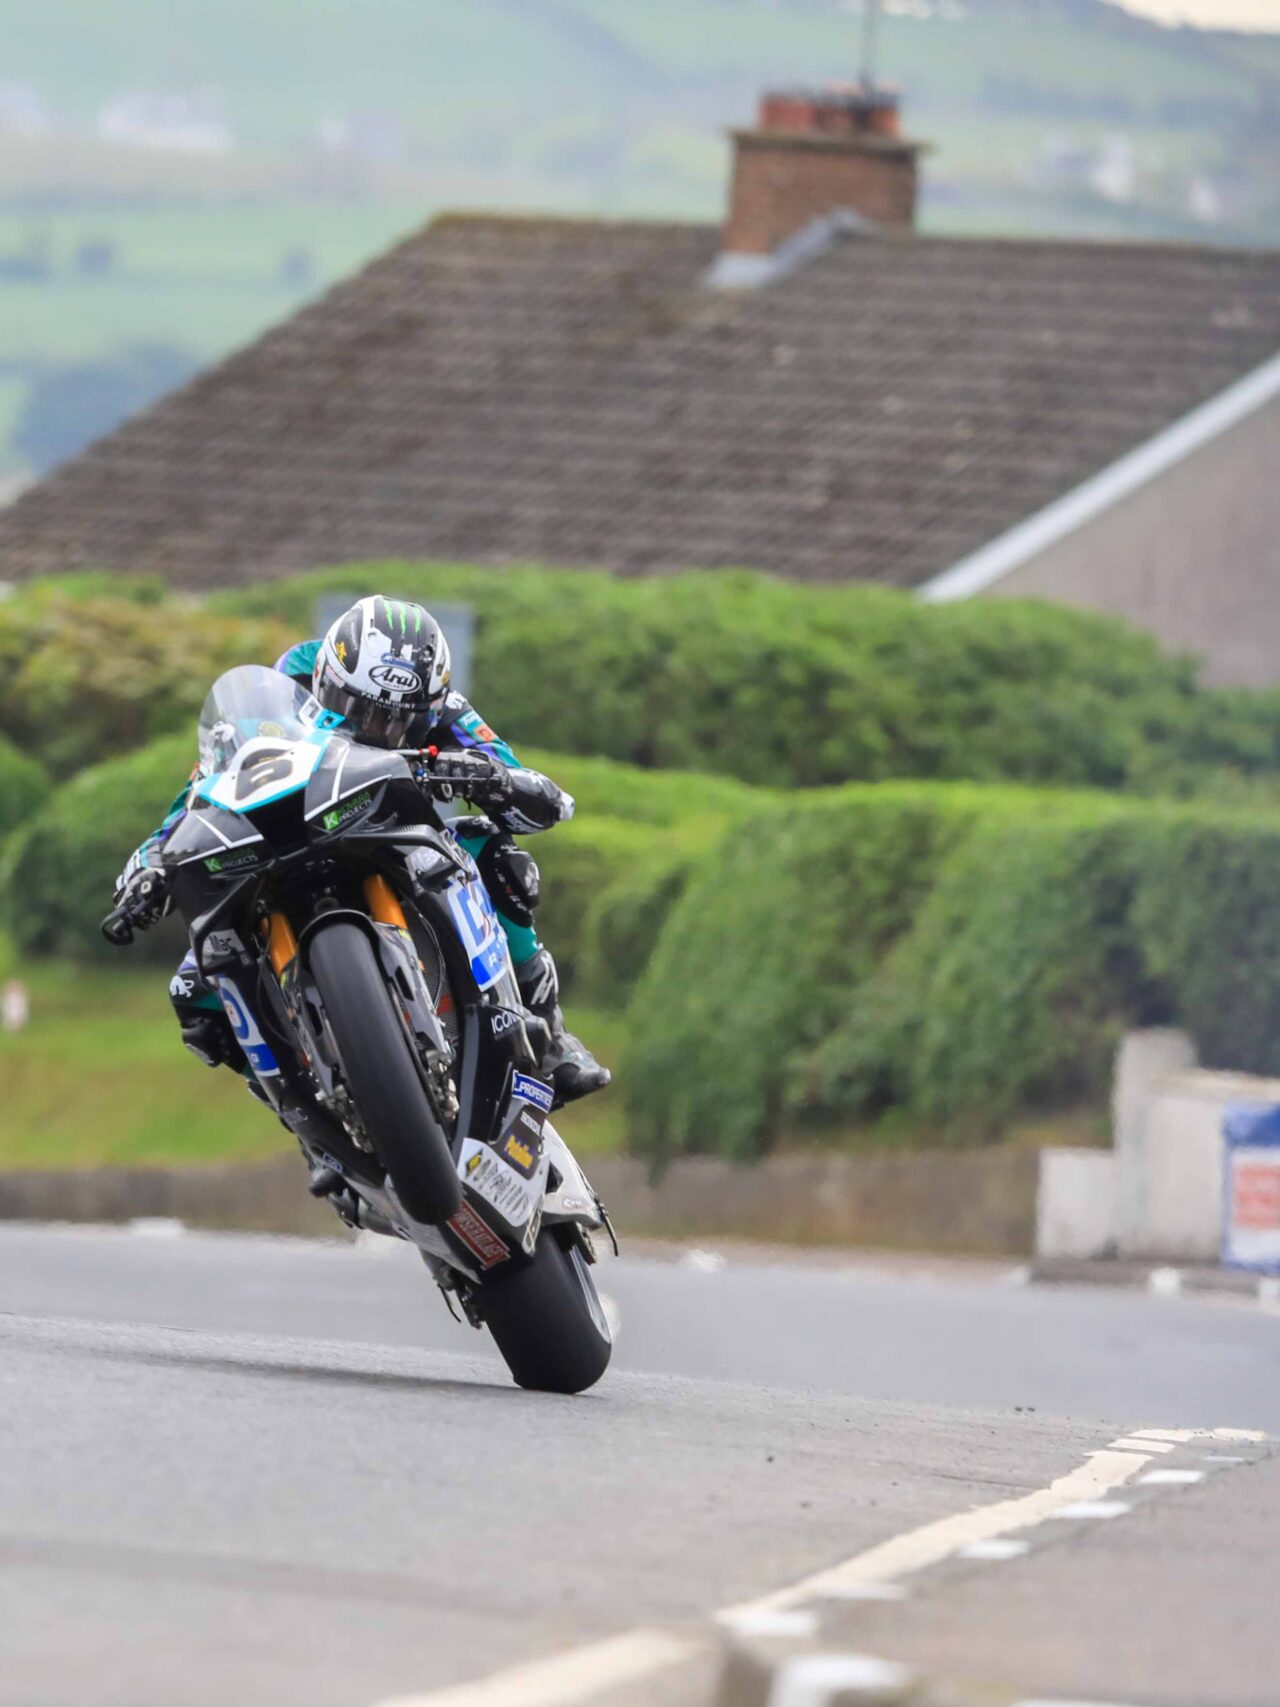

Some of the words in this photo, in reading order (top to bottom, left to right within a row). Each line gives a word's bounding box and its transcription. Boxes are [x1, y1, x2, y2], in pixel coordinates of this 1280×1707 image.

[373, 667, 416, 689] Arai
[235, 748, 294, 801] 6
[339, 799, 375, 822] PROJECTS
